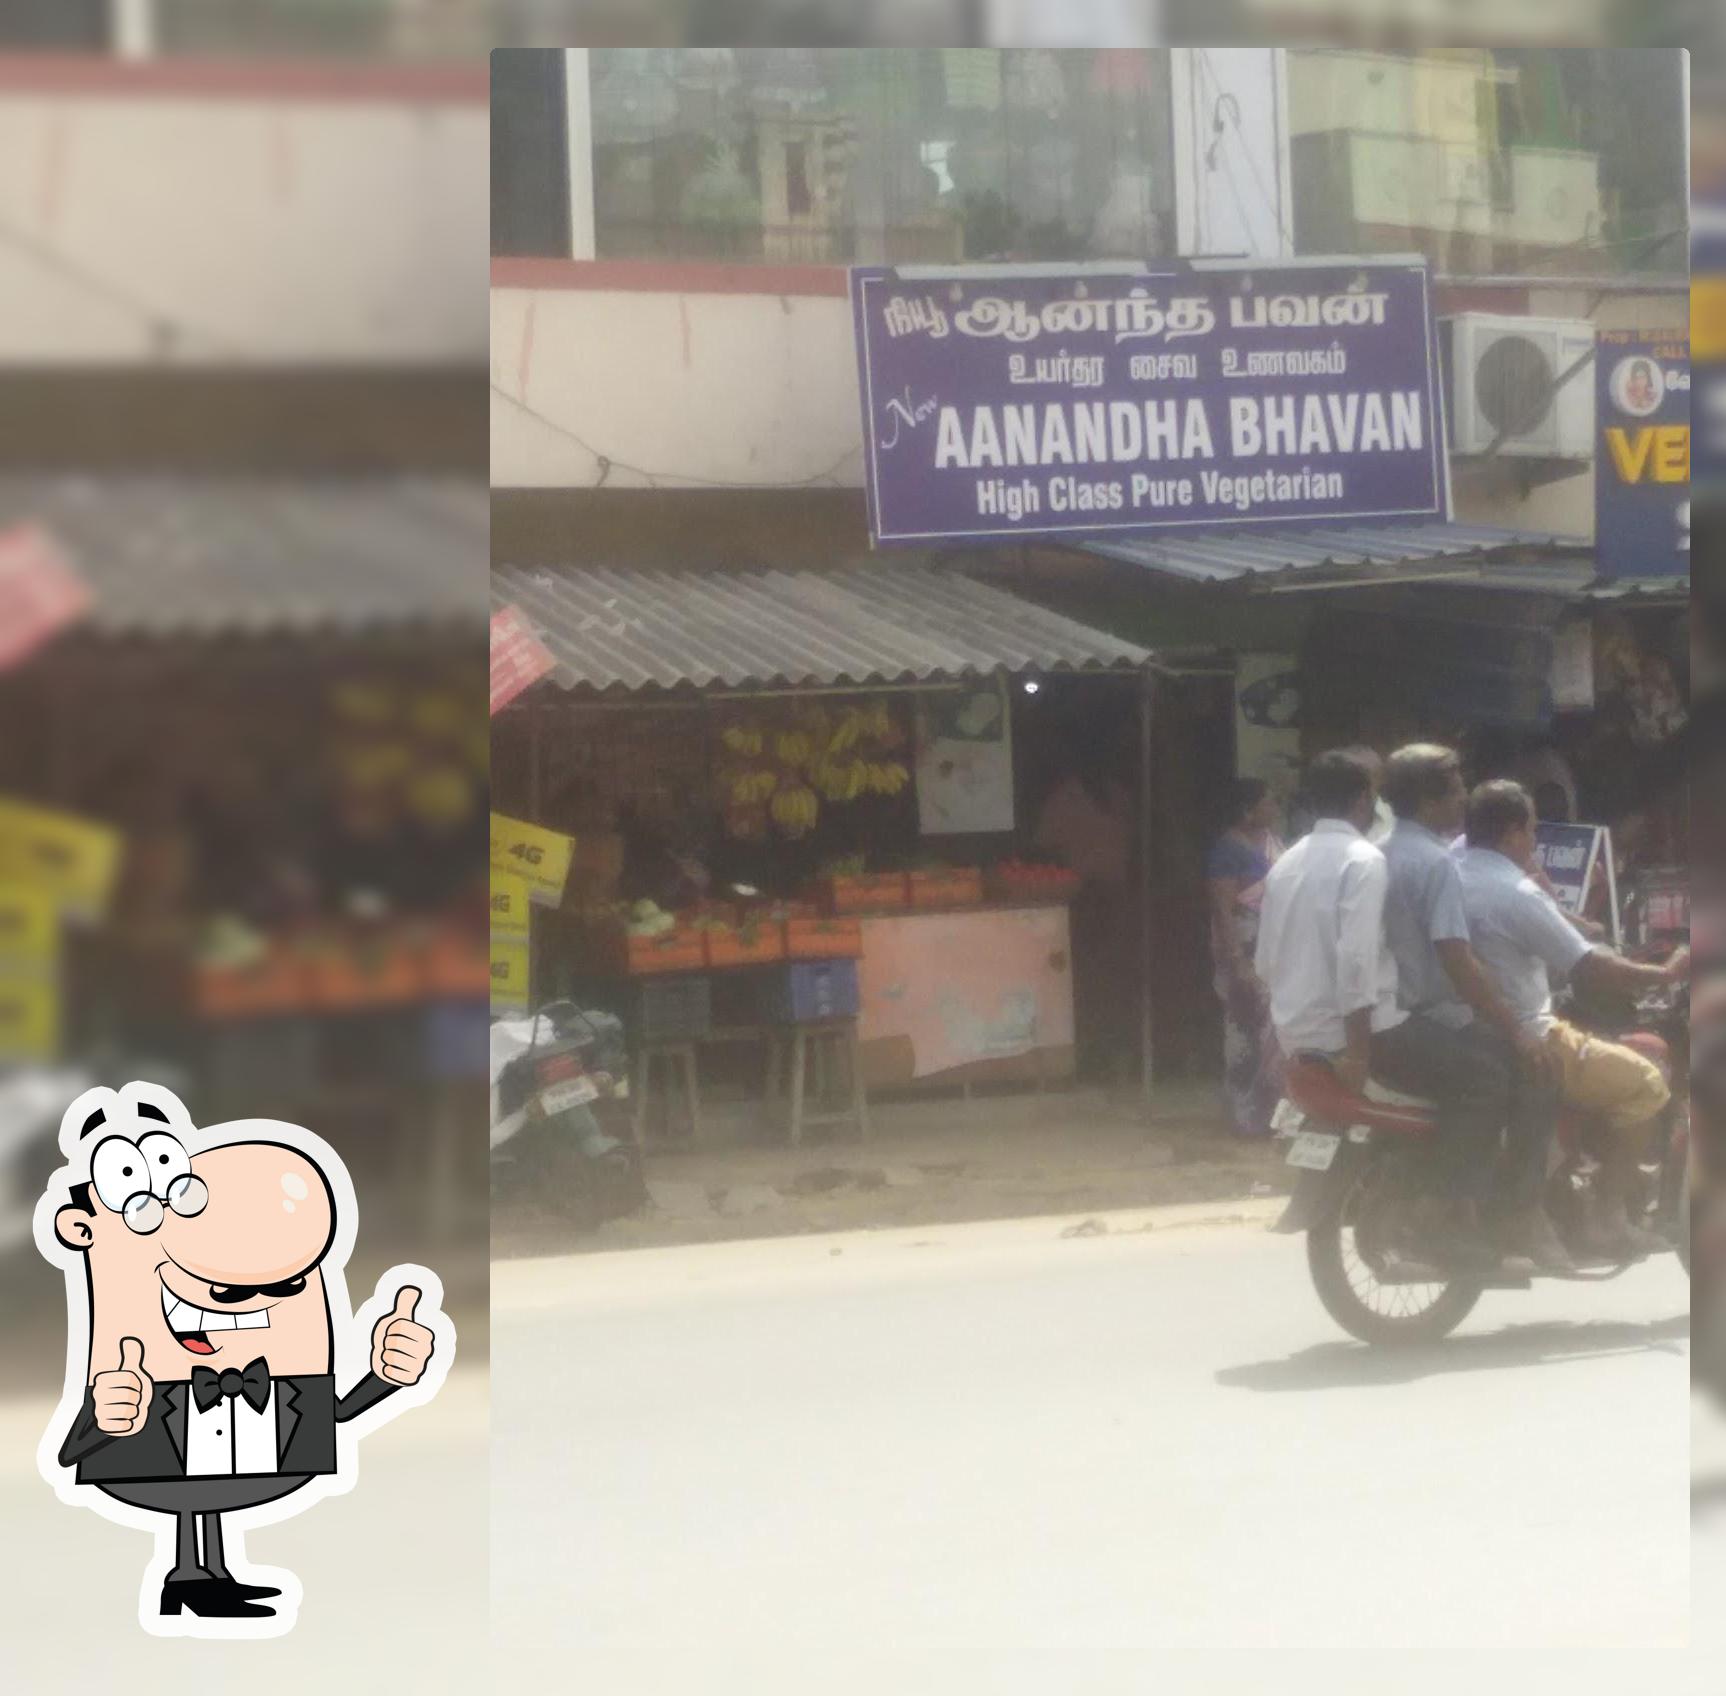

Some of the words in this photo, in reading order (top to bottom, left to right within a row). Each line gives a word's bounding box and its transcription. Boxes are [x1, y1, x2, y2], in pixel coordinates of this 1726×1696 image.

[1130, 353, 1197, 380] சைவ
[1221, 341, 1347, 378] உணவகம்
[933, 398, 1215, 469] AANANDHA
[1229, 391, 1423, 457] BHAVAN
[976, 479, 1041, 521] High
[1048, 475, 1123, 512] Class
[1130, 473, 1194, 508] Pure
[1200, 466, 1344, 511] Vegetarian
[508, 843, 545, 865] 4G
